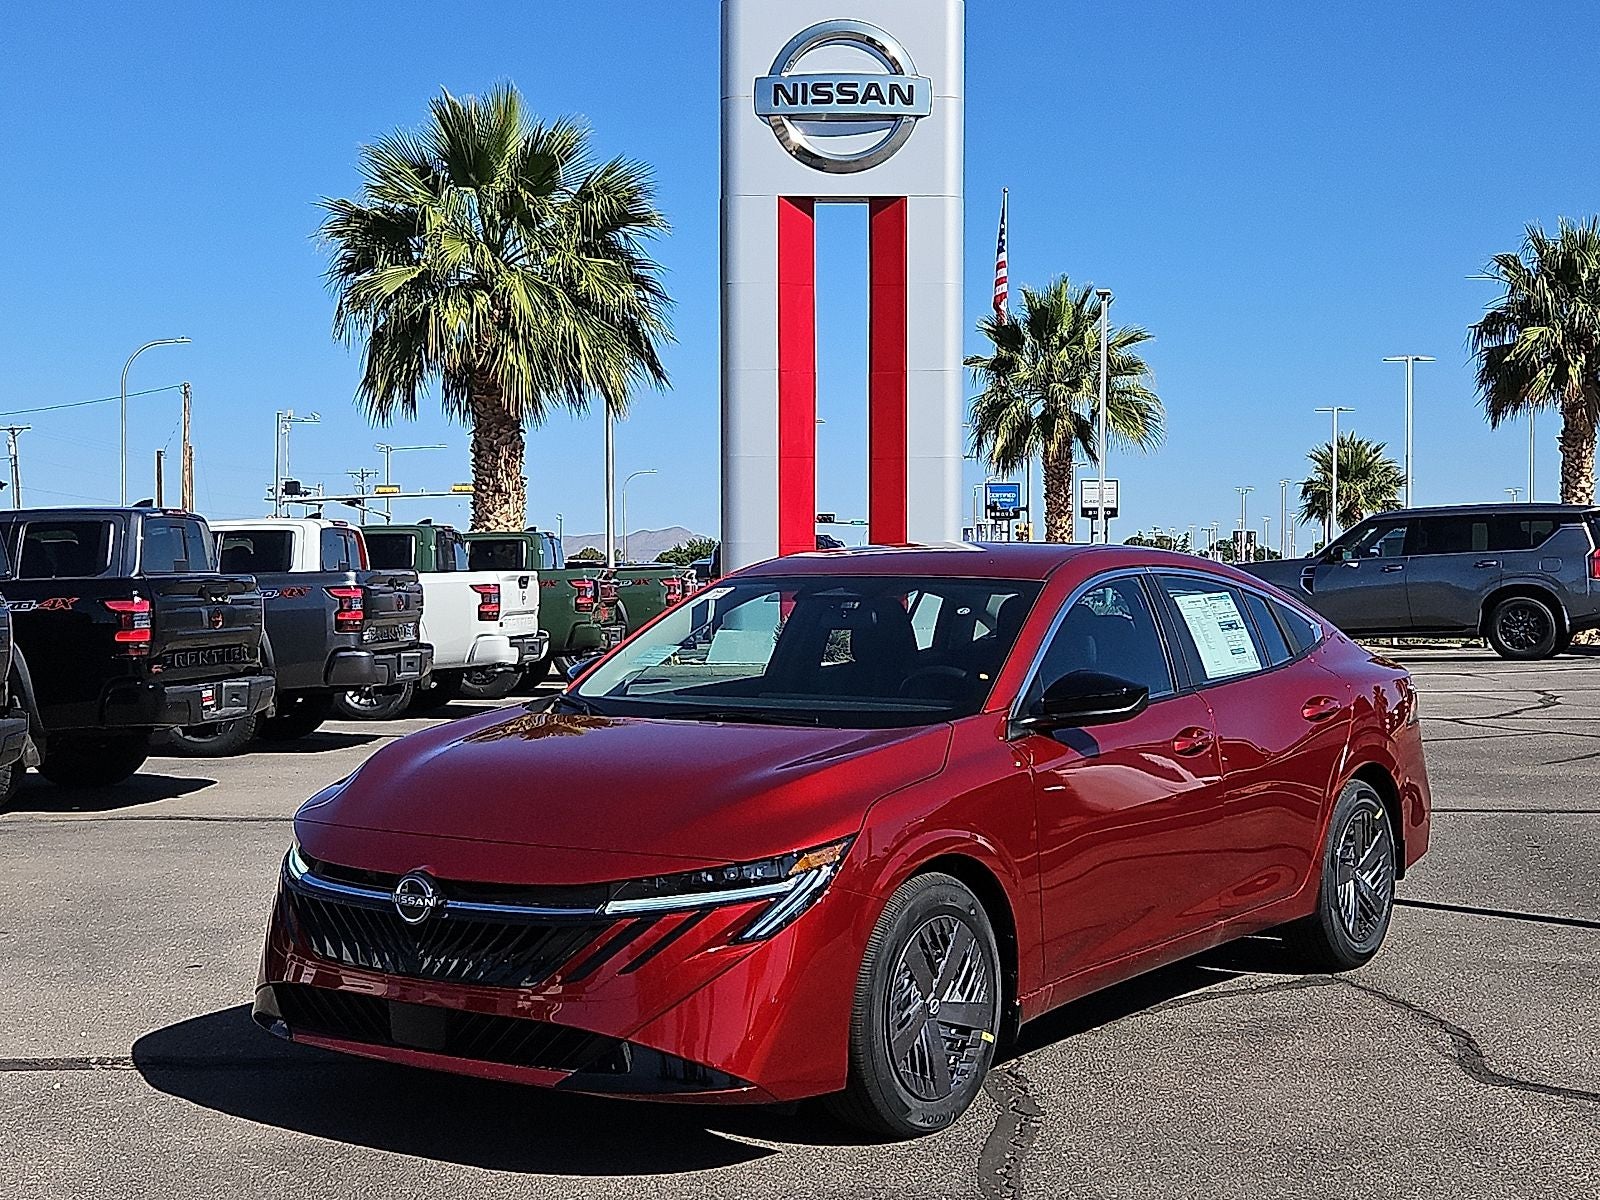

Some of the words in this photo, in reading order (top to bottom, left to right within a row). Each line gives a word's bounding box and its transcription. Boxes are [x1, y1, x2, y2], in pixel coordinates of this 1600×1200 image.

[773, 82, 914, 106] NISSAN
[161, 646, 250, 668] FRONTIER
[392, 893, 435, 908] NISSAN
